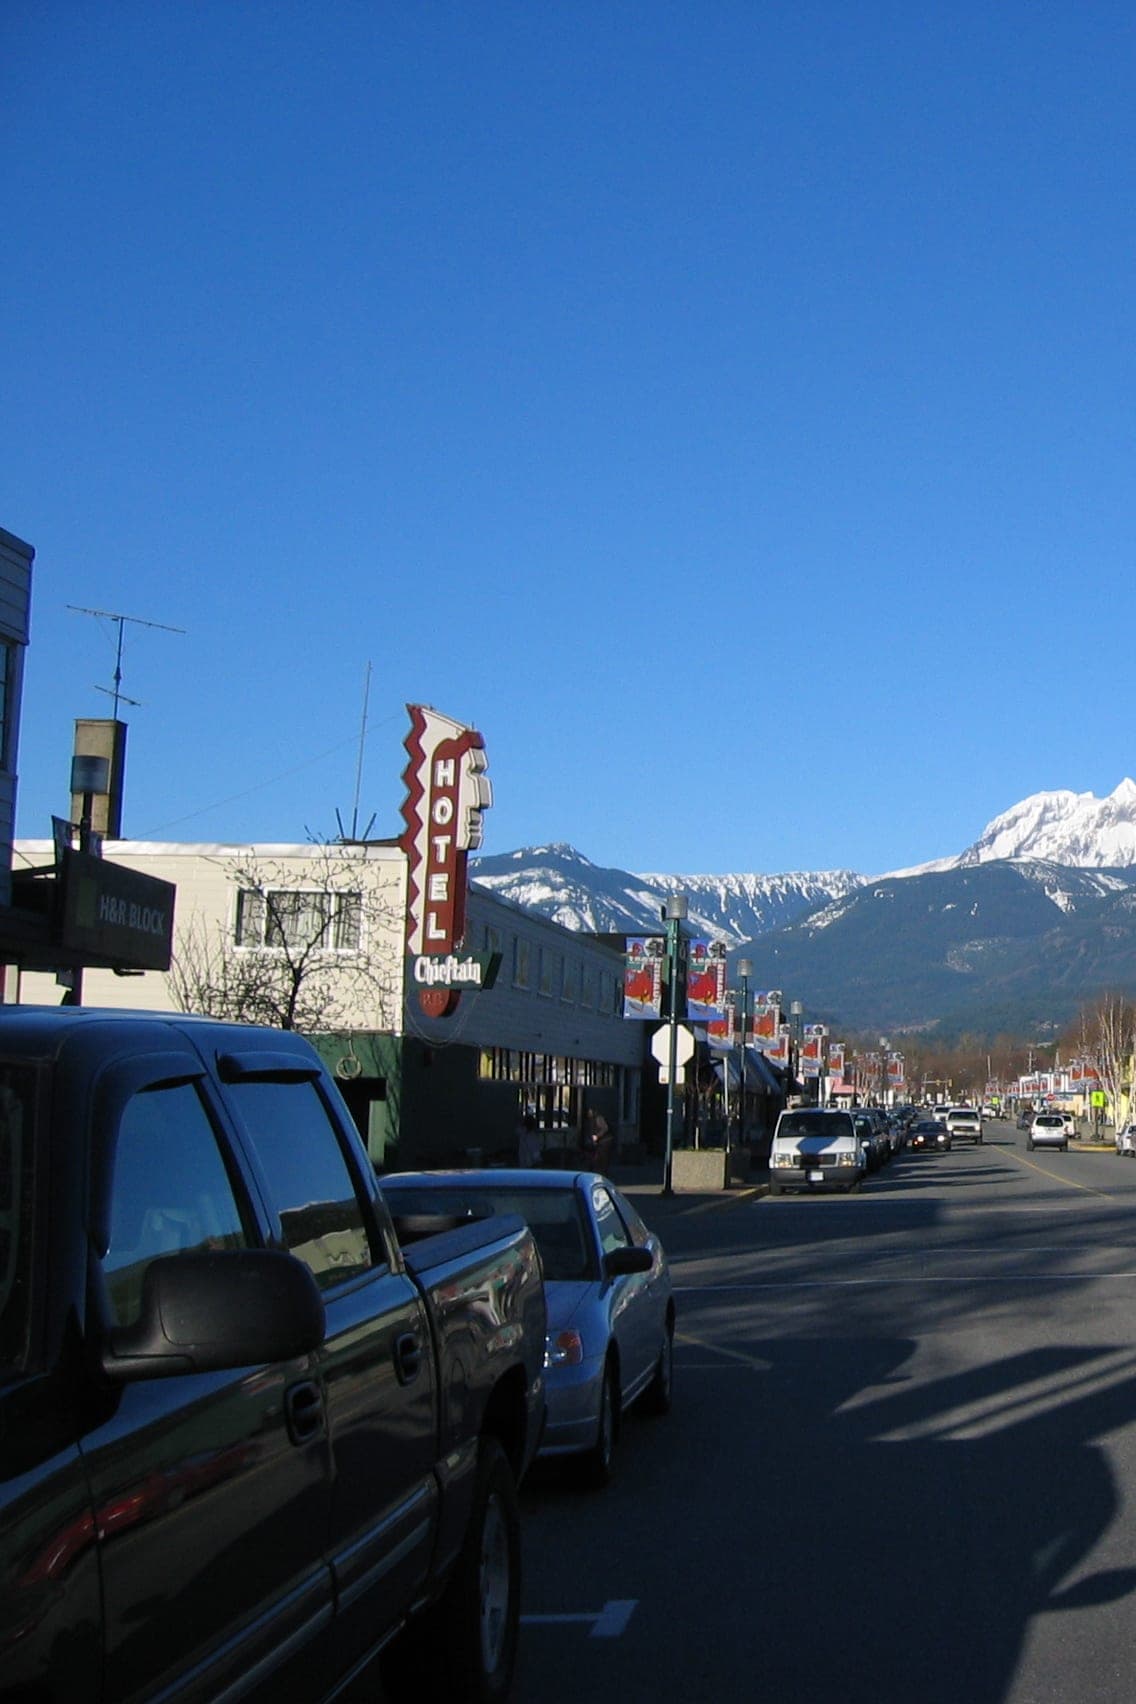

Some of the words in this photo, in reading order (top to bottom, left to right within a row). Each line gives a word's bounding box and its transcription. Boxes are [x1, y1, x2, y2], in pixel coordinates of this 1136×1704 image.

[427, 758, 454, 941] HOTEL
[100, 895, 126, 926] H&R
[130, 903, 164, 936] BLOCK
[414, 954, 482, 986] Chieftain
